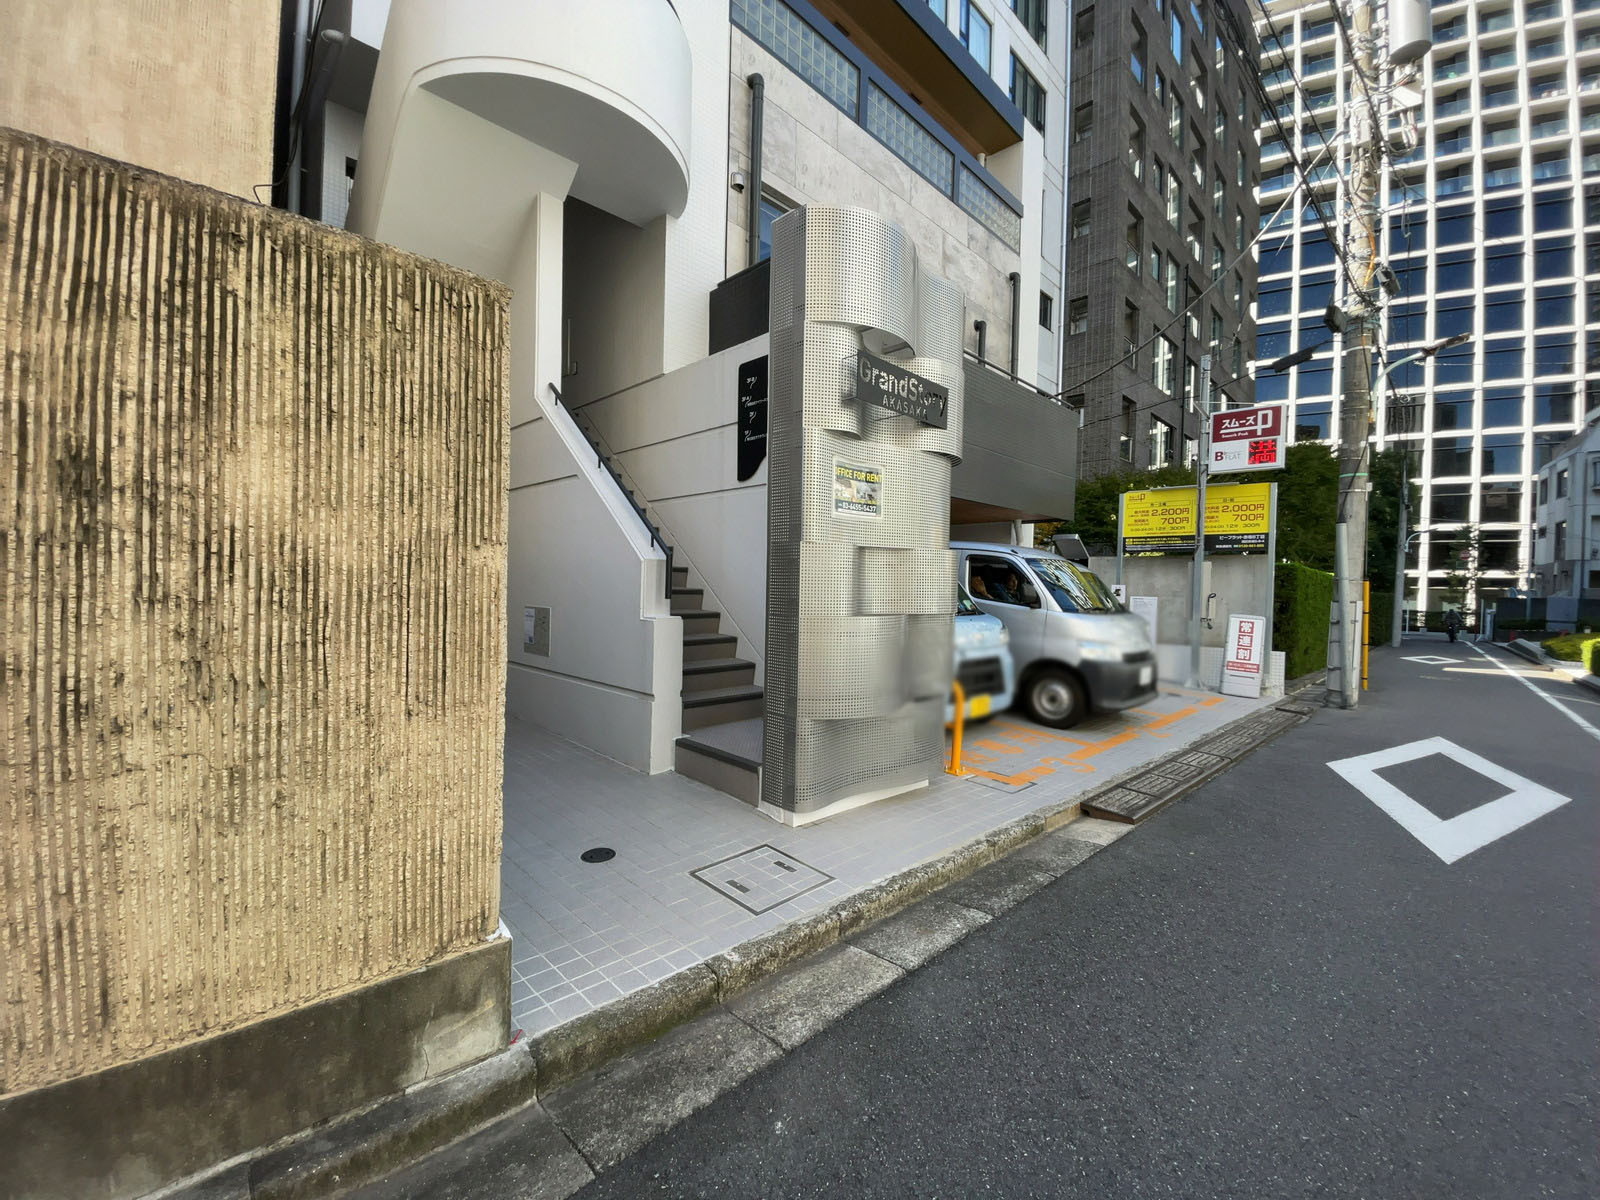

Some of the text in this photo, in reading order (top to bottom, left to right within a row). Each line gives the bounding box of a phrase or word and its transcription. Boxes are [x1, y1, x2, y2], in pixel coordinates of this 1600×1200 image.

[882, 394, 928, 421] AKASAKA
[1221, 415, 1257, 429] スムーズ
[1248, 440, 1277, 464] 満
[1160, 516, 1190, 525] 700円
[1232, 513, 1265, 522] 700円
